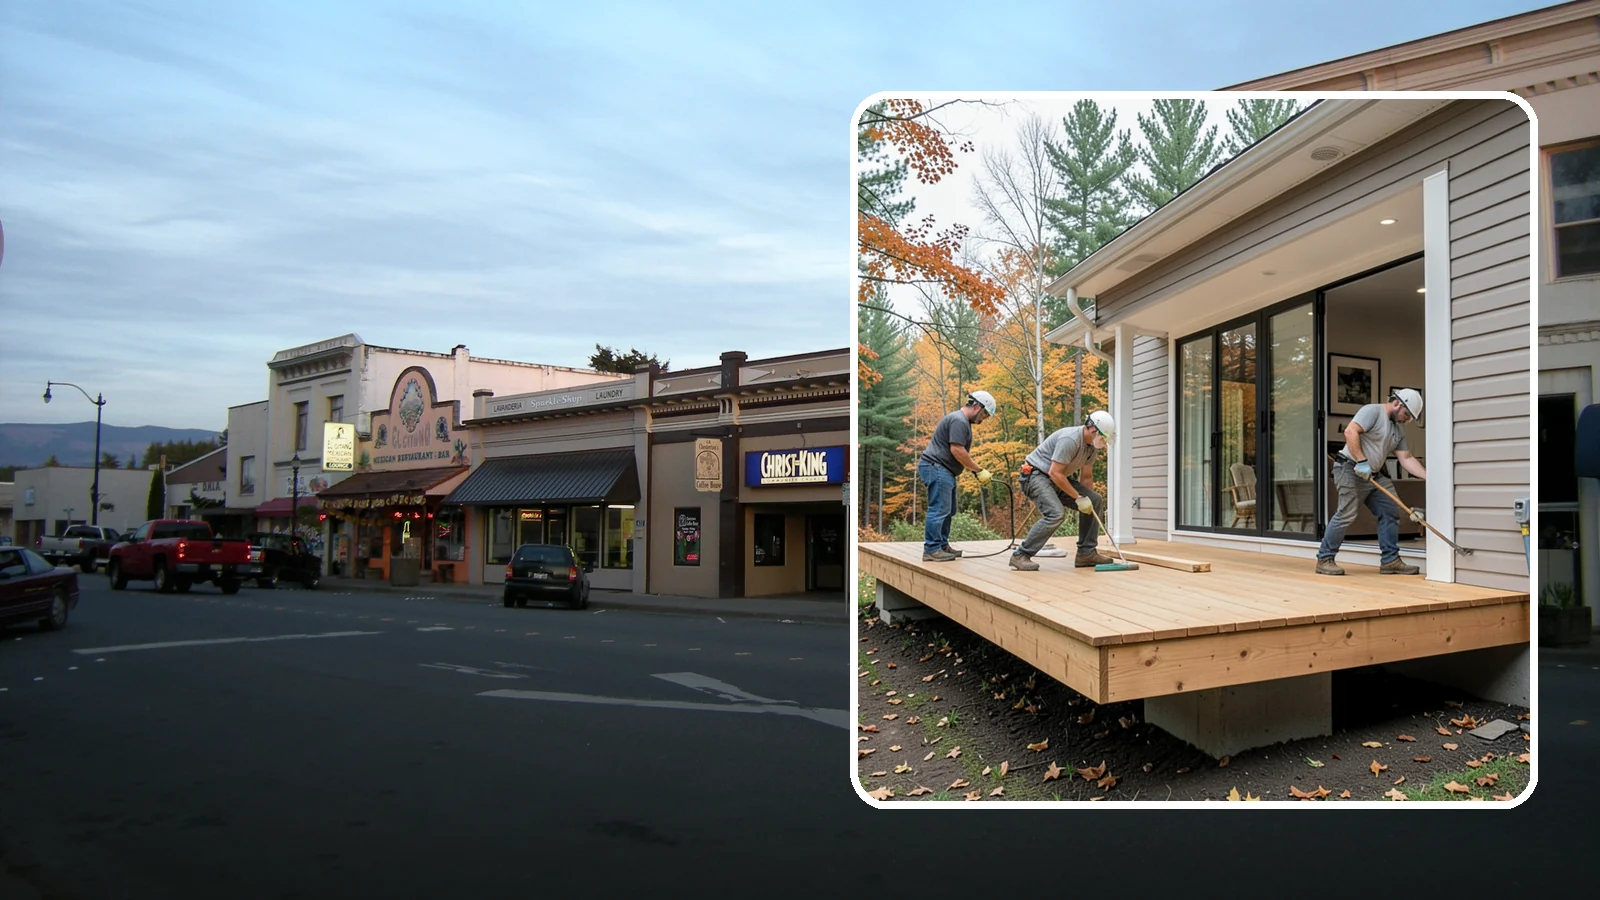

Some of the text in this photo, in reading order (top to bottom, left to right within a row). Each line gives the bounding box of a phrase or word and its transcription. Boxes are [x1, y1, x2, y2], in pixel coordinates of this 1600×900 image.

[595, 389, 623, 400] LAUNDRY
[493, 402, 523, 413] LAVANDERIA
[530, 395, 582, 409] Sparkle Shop
[373, 454, 396, 464] MEXICAN
[397, 451, 433, 463] RESTAURANT
[437, 450, 450, 460] BAR
[761, 450, 827, 478] CHRIST KING
